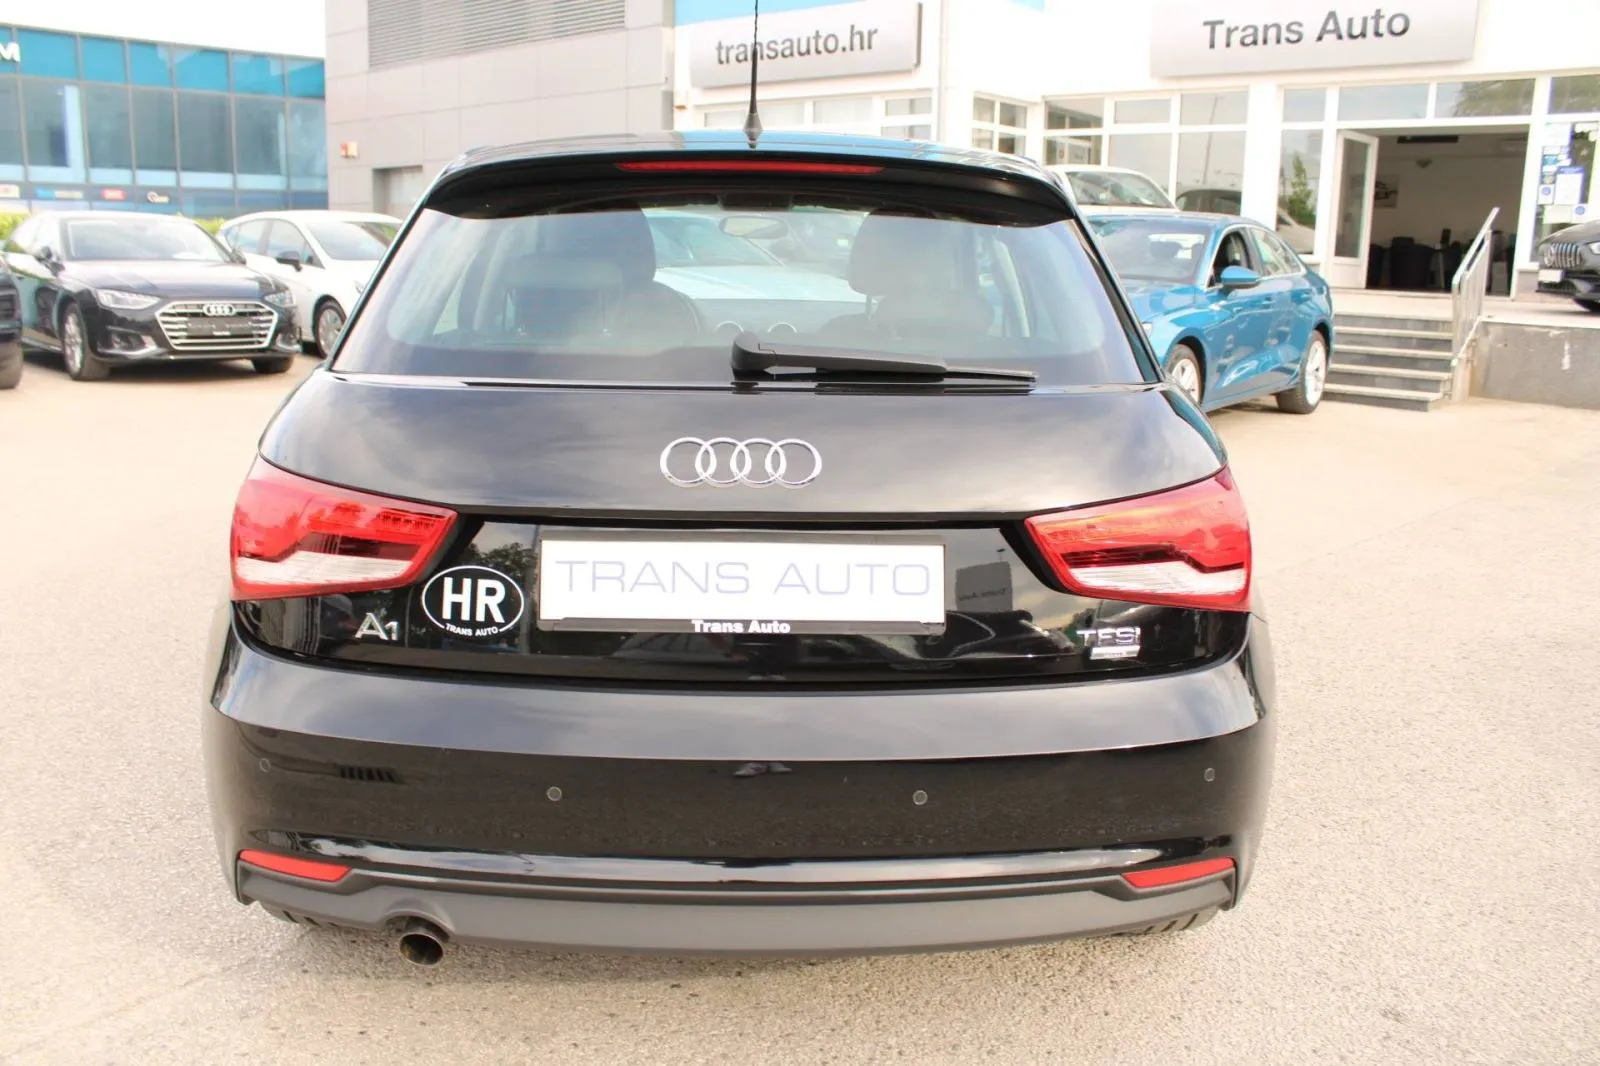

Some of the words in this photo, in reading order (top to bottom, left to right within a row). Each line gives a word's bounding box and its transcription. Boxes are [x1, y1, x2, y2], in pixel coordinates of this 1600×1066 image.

[1203, 20, 1304, 49] Trans
[1315, 9, 1410, 42] Auto
[716, 25, 878, 65] transauto.hr
[556, 561, 750, 594] TRANS
[773, 562, 930, 595] AUTO
[442, 577, 506, 623] HR
[355, 612, 398, 641] A1
[445, 622, 473, 636] TRANS
[475, 626, 499, 637] AUTO
[691, 619, 744, 634] Trans
[748, 620, 791, 634] Auto
[1076, 626, 1141, 646] TFSI
